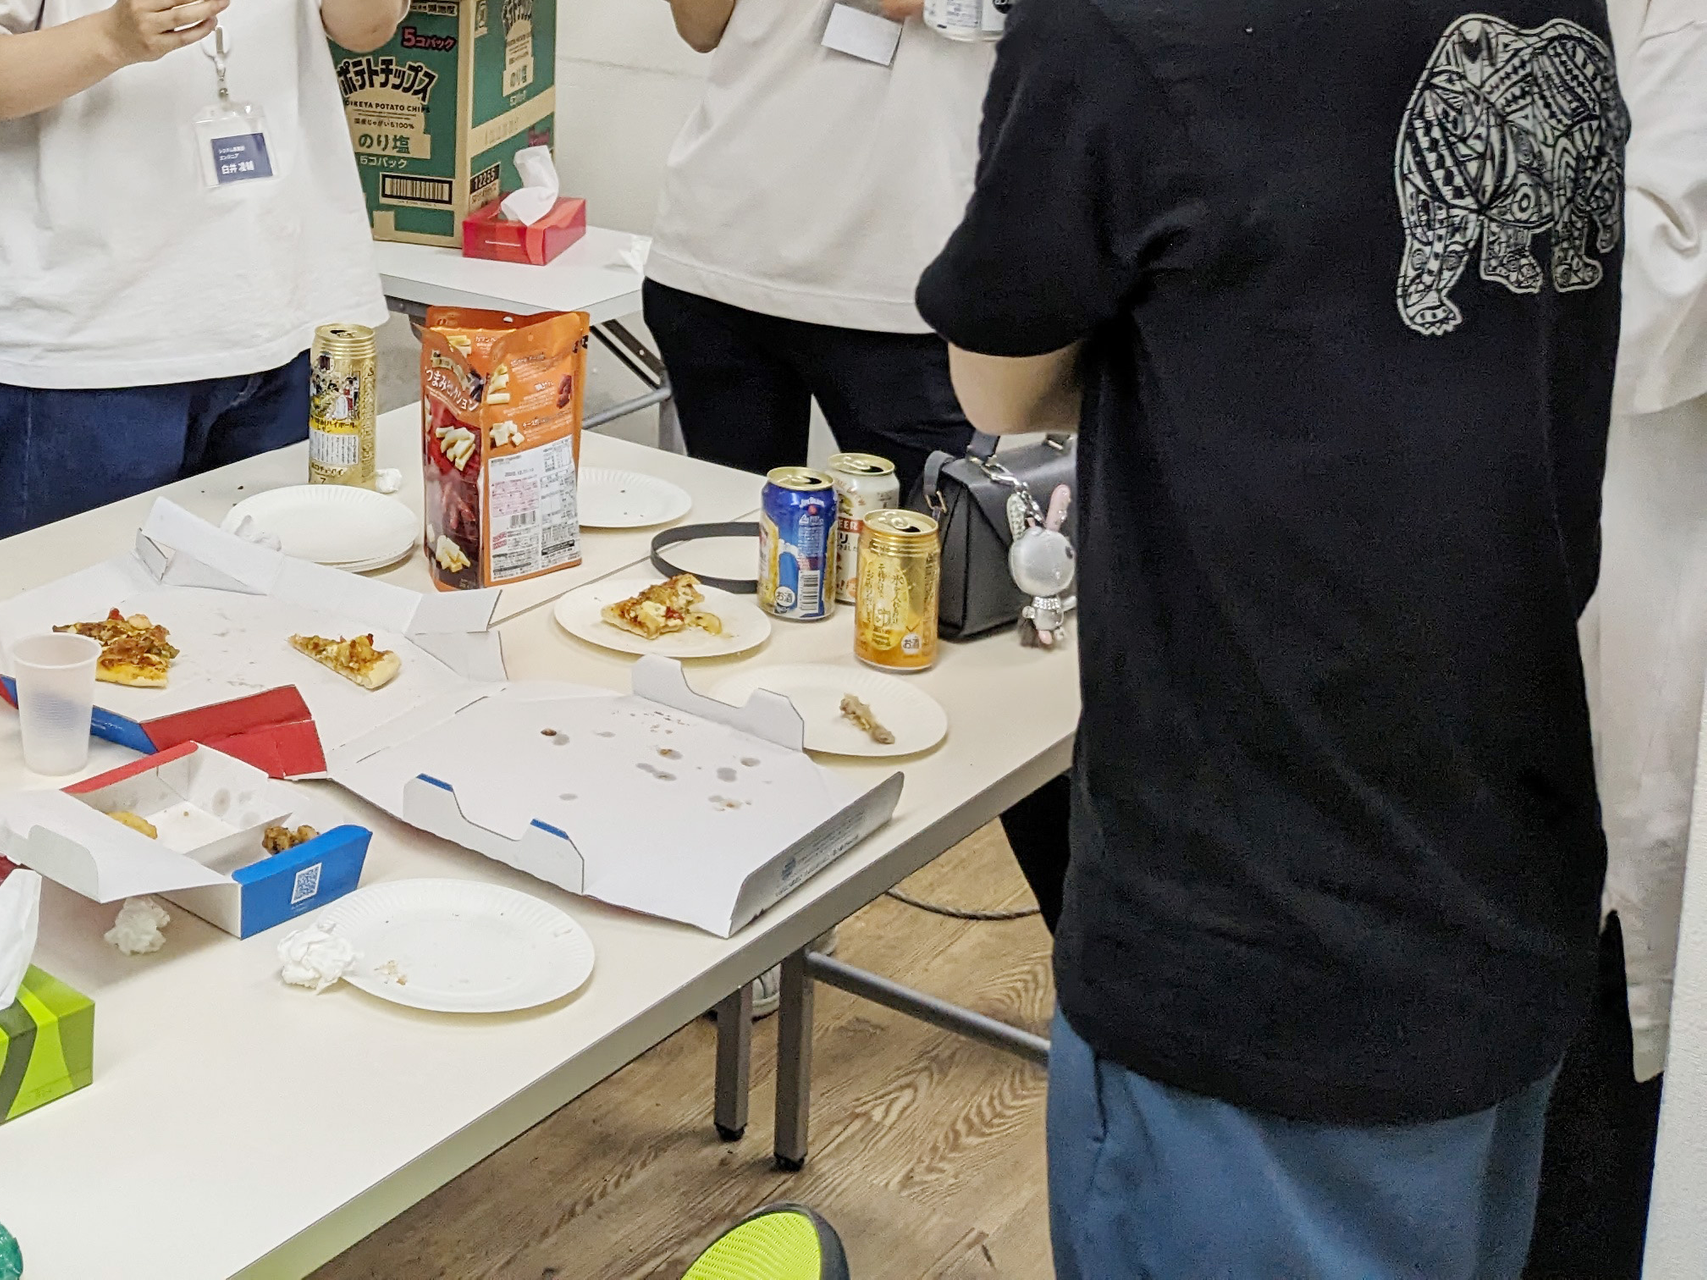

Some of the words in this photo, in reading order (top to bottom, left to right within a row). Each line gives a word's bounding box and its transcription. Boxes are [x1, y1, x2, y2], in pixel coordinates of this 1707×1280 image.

[403, 28, 454, 50] 5コパック
[336, 57, 437, 103] ポテトチップス
[375, 102, 405, 111] POTATO
[359, 134, 410, 154] のり塩
[360, 155, 407, 169] 5コパック
[839, 520, 858, 530] EER
